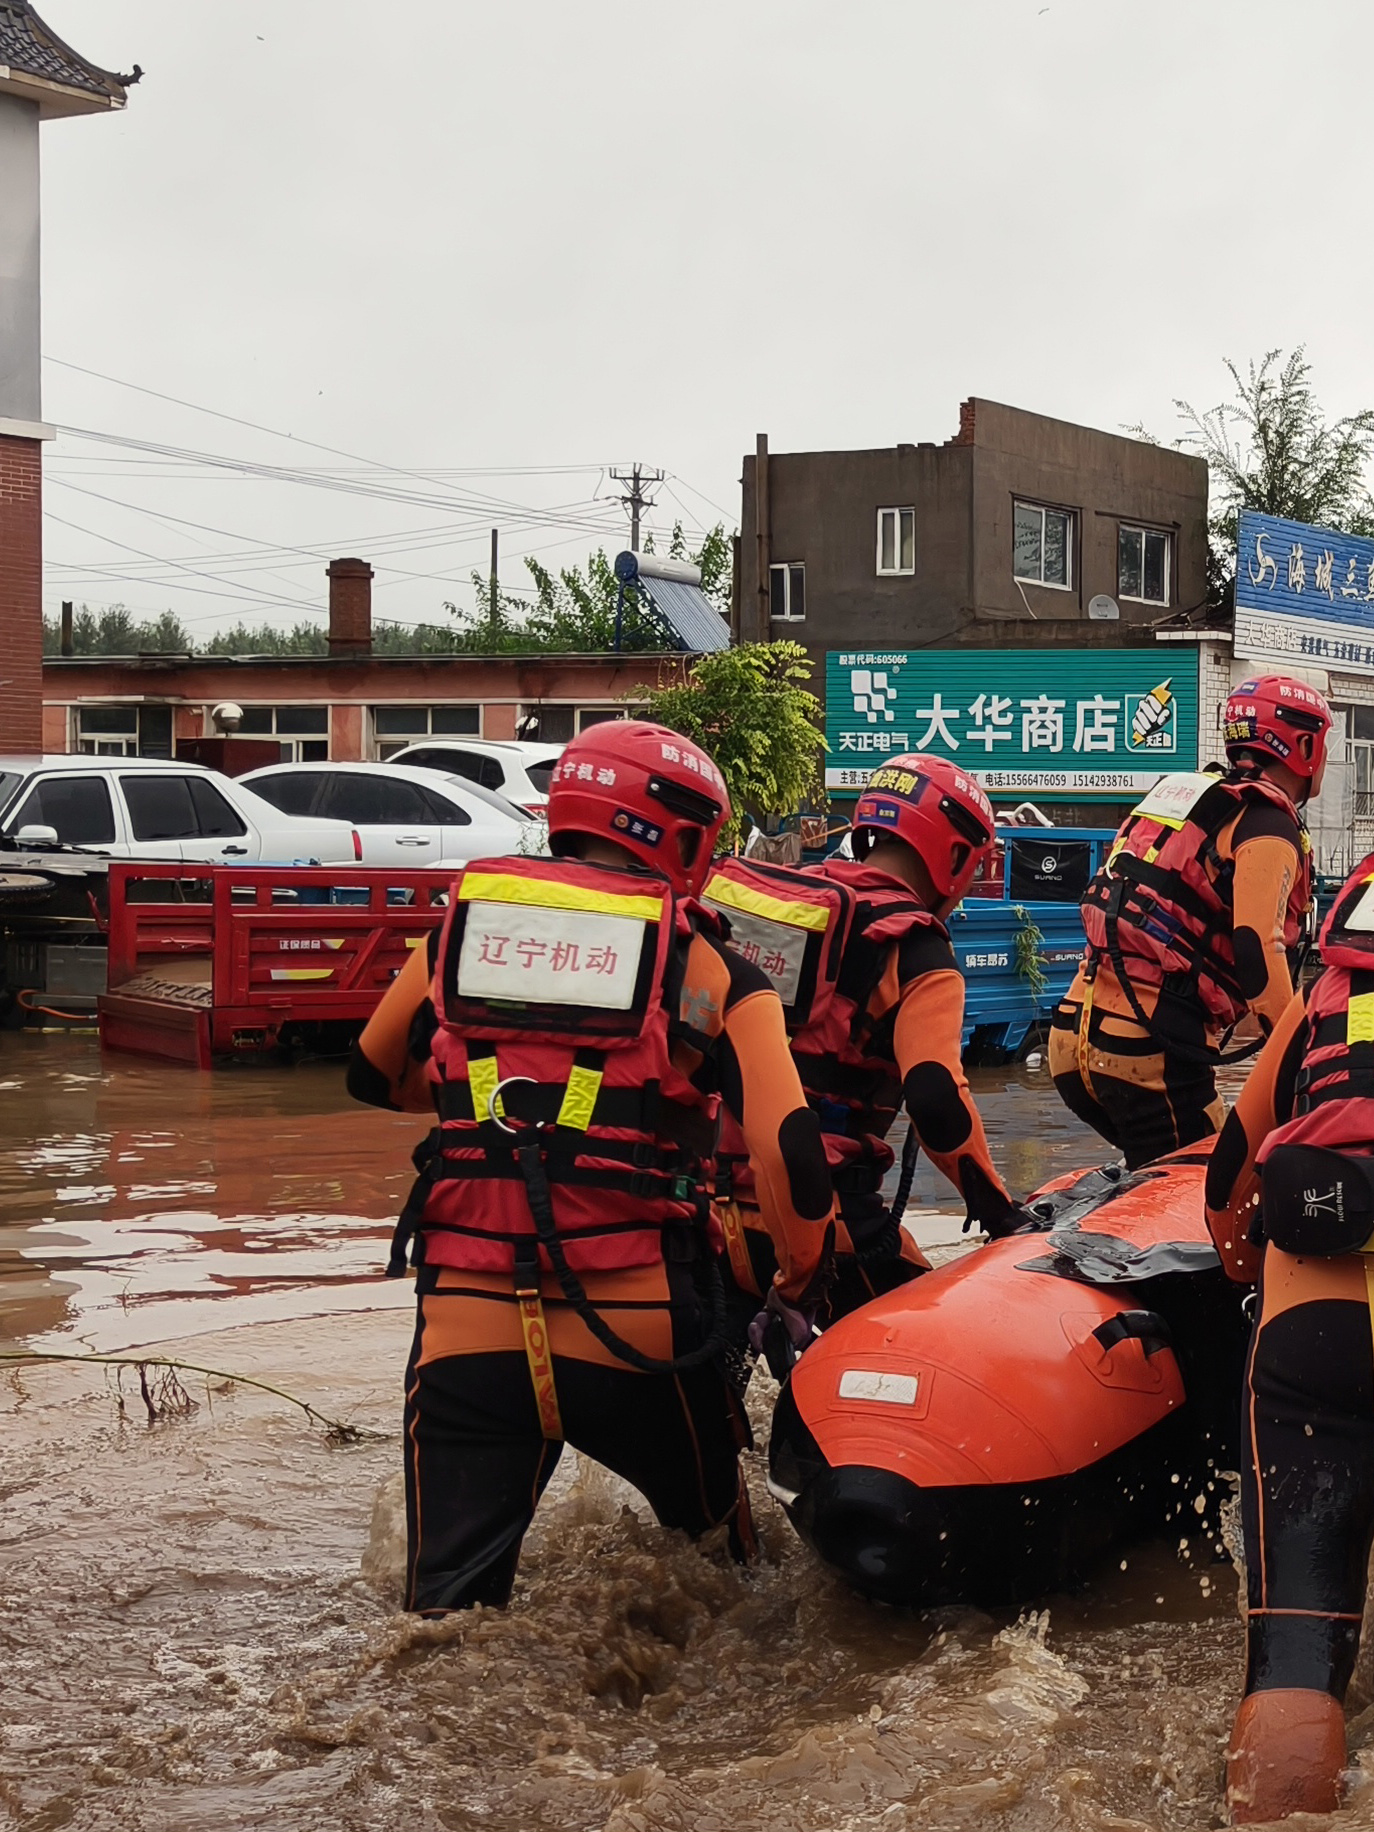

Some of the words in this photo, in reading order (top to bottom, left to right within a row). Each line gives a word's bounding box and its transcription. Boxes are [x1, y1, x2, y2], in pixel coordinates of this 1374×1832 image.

[1244, 620, 1297, 650] 大华商店
[915, 692, 1122, 753] 大华商店
[838, 732, 910, 752] 天正电气
[985, 773, 1067, 787] 电话:15566476059
[1072, 775, 1134, 788] 15142938761
[478, 933, 619, 977] 辽宁机动
